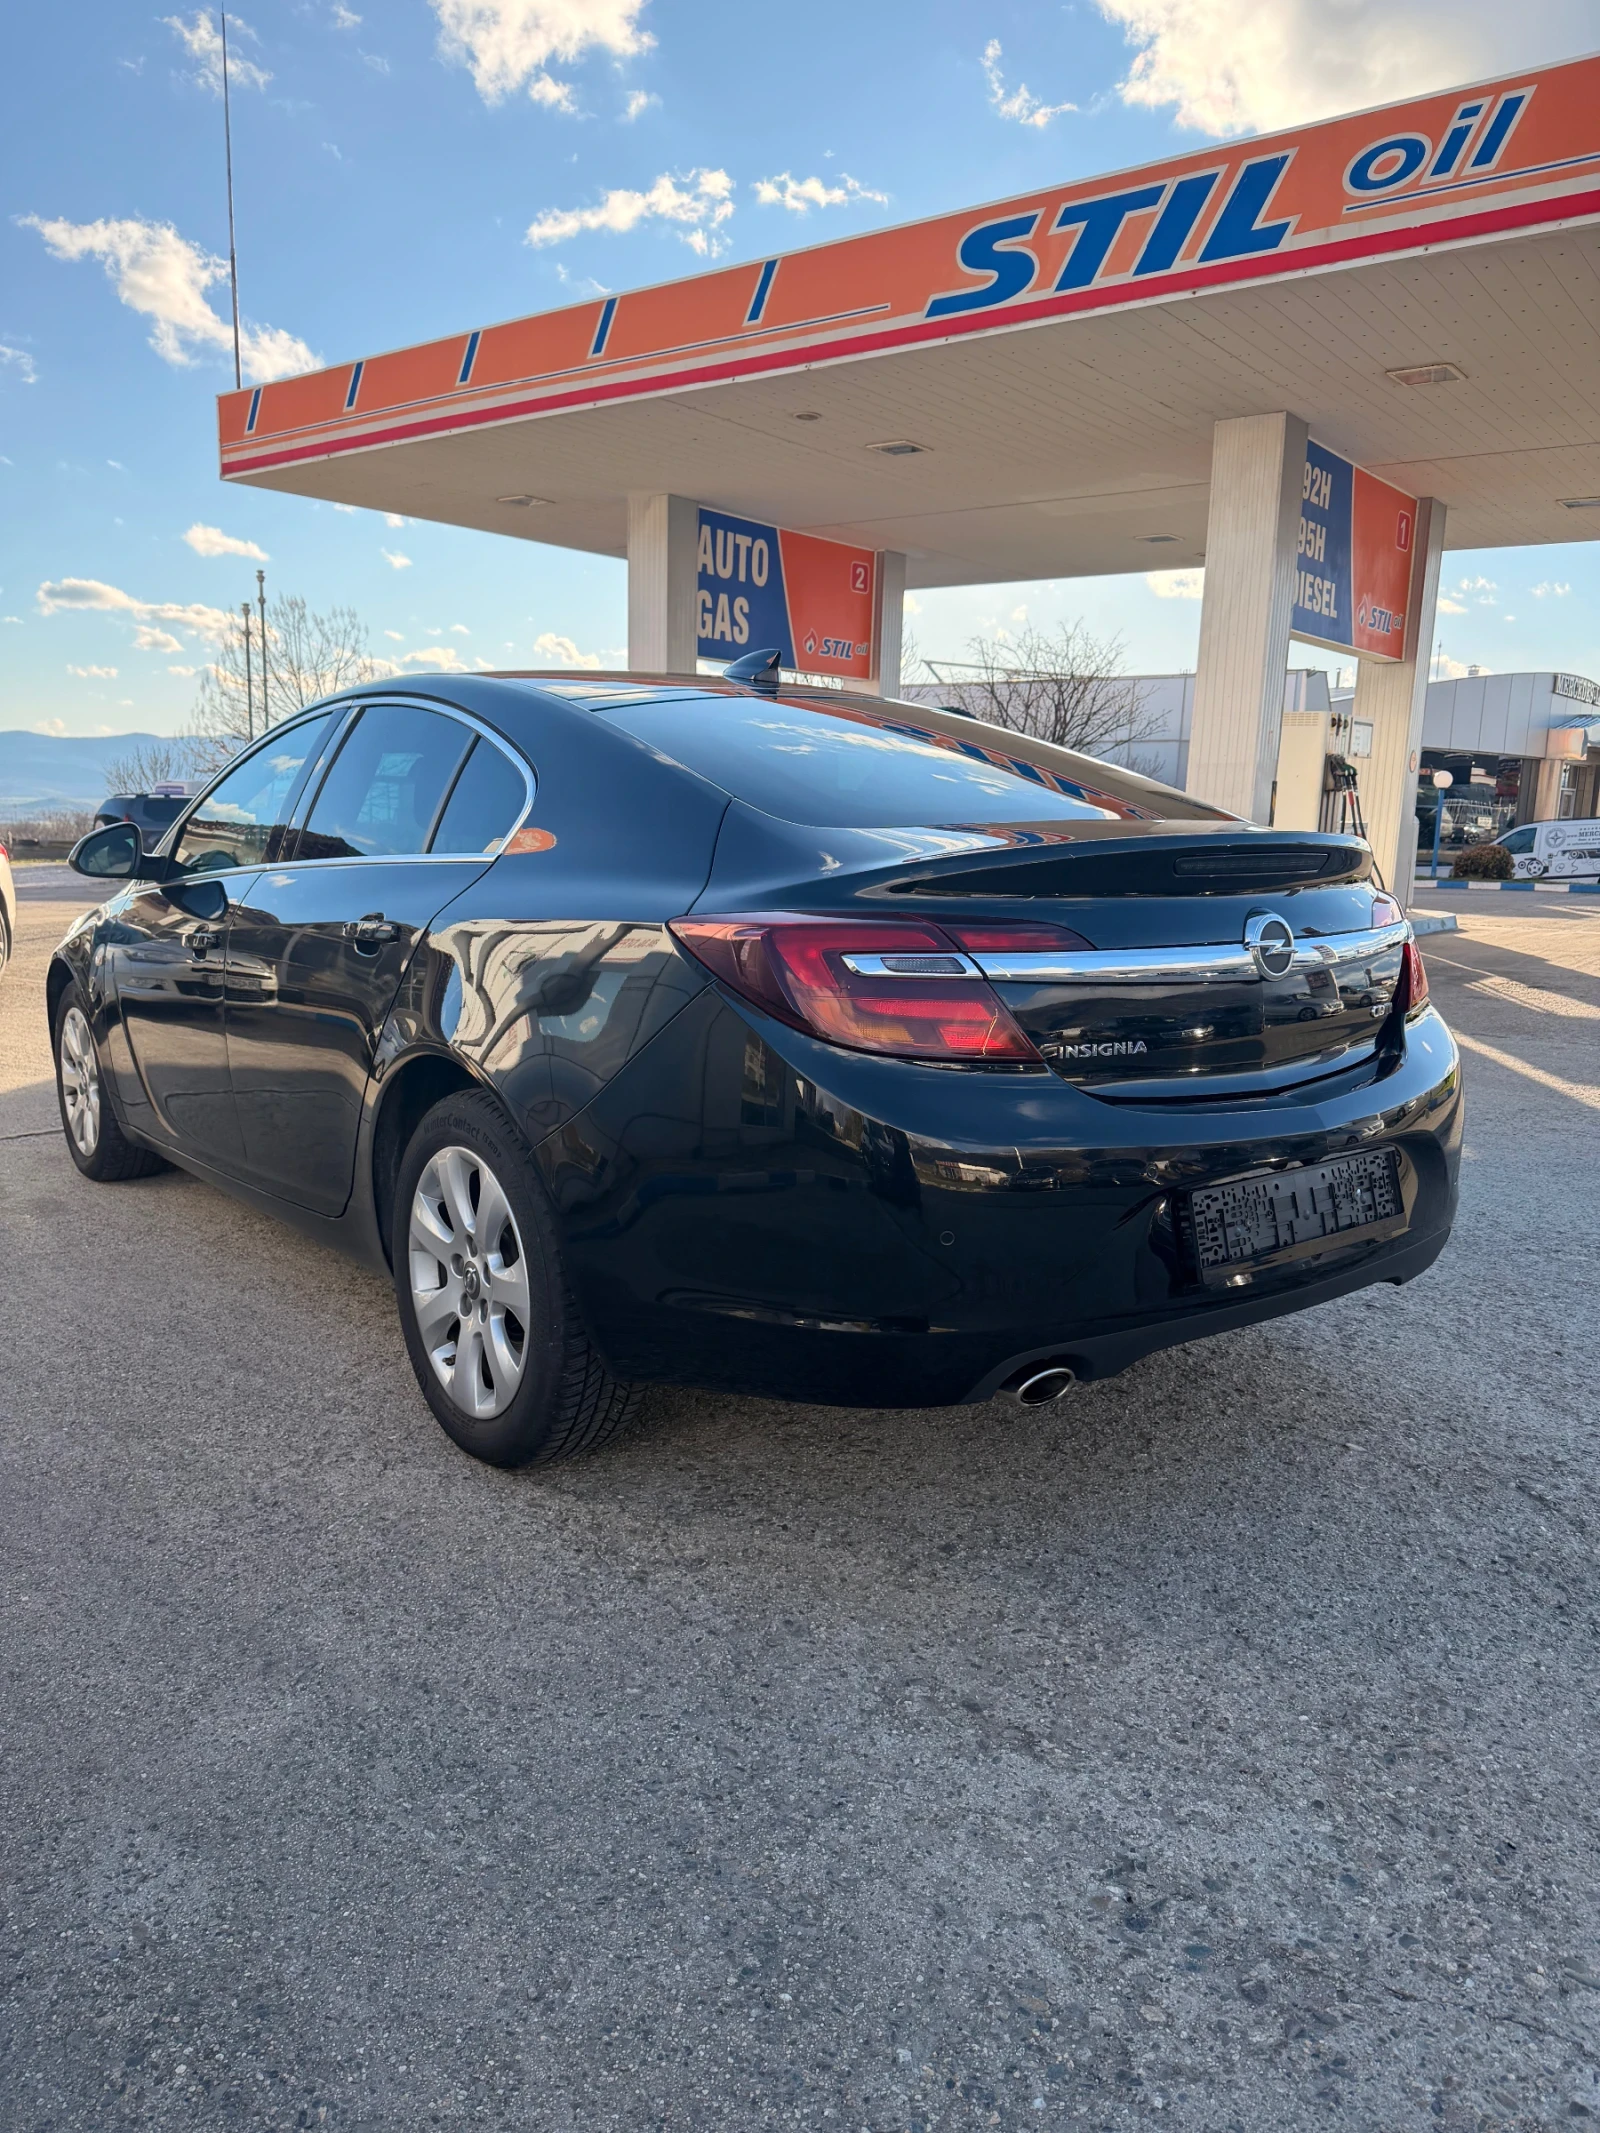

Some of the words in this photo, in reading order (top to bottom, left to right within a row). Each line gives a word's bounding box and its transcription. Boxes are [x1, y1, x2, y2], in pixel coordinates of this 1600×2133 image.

[923, 152, 1297, 319] STIL
[1345, 91, 1529, 194] oil
[1303, 461, 1332, 510] 92H
[1297, 516, 1327, 563] 95H
[1401, 519, 1406, 544] 1
[698, 524, 769, 587] AUTO
[855, 568, 865, 589] 2
[697, 589, 750, 645] GAS
[1368, 606, 1392, 634] STIL
[819, 637, 853, 660] STIL
[856, 642, 869, 655] oil
[1059, 1040, 1147, 1059] INSIGNIA
[423, 1113, 481, 1142] WinterContact
